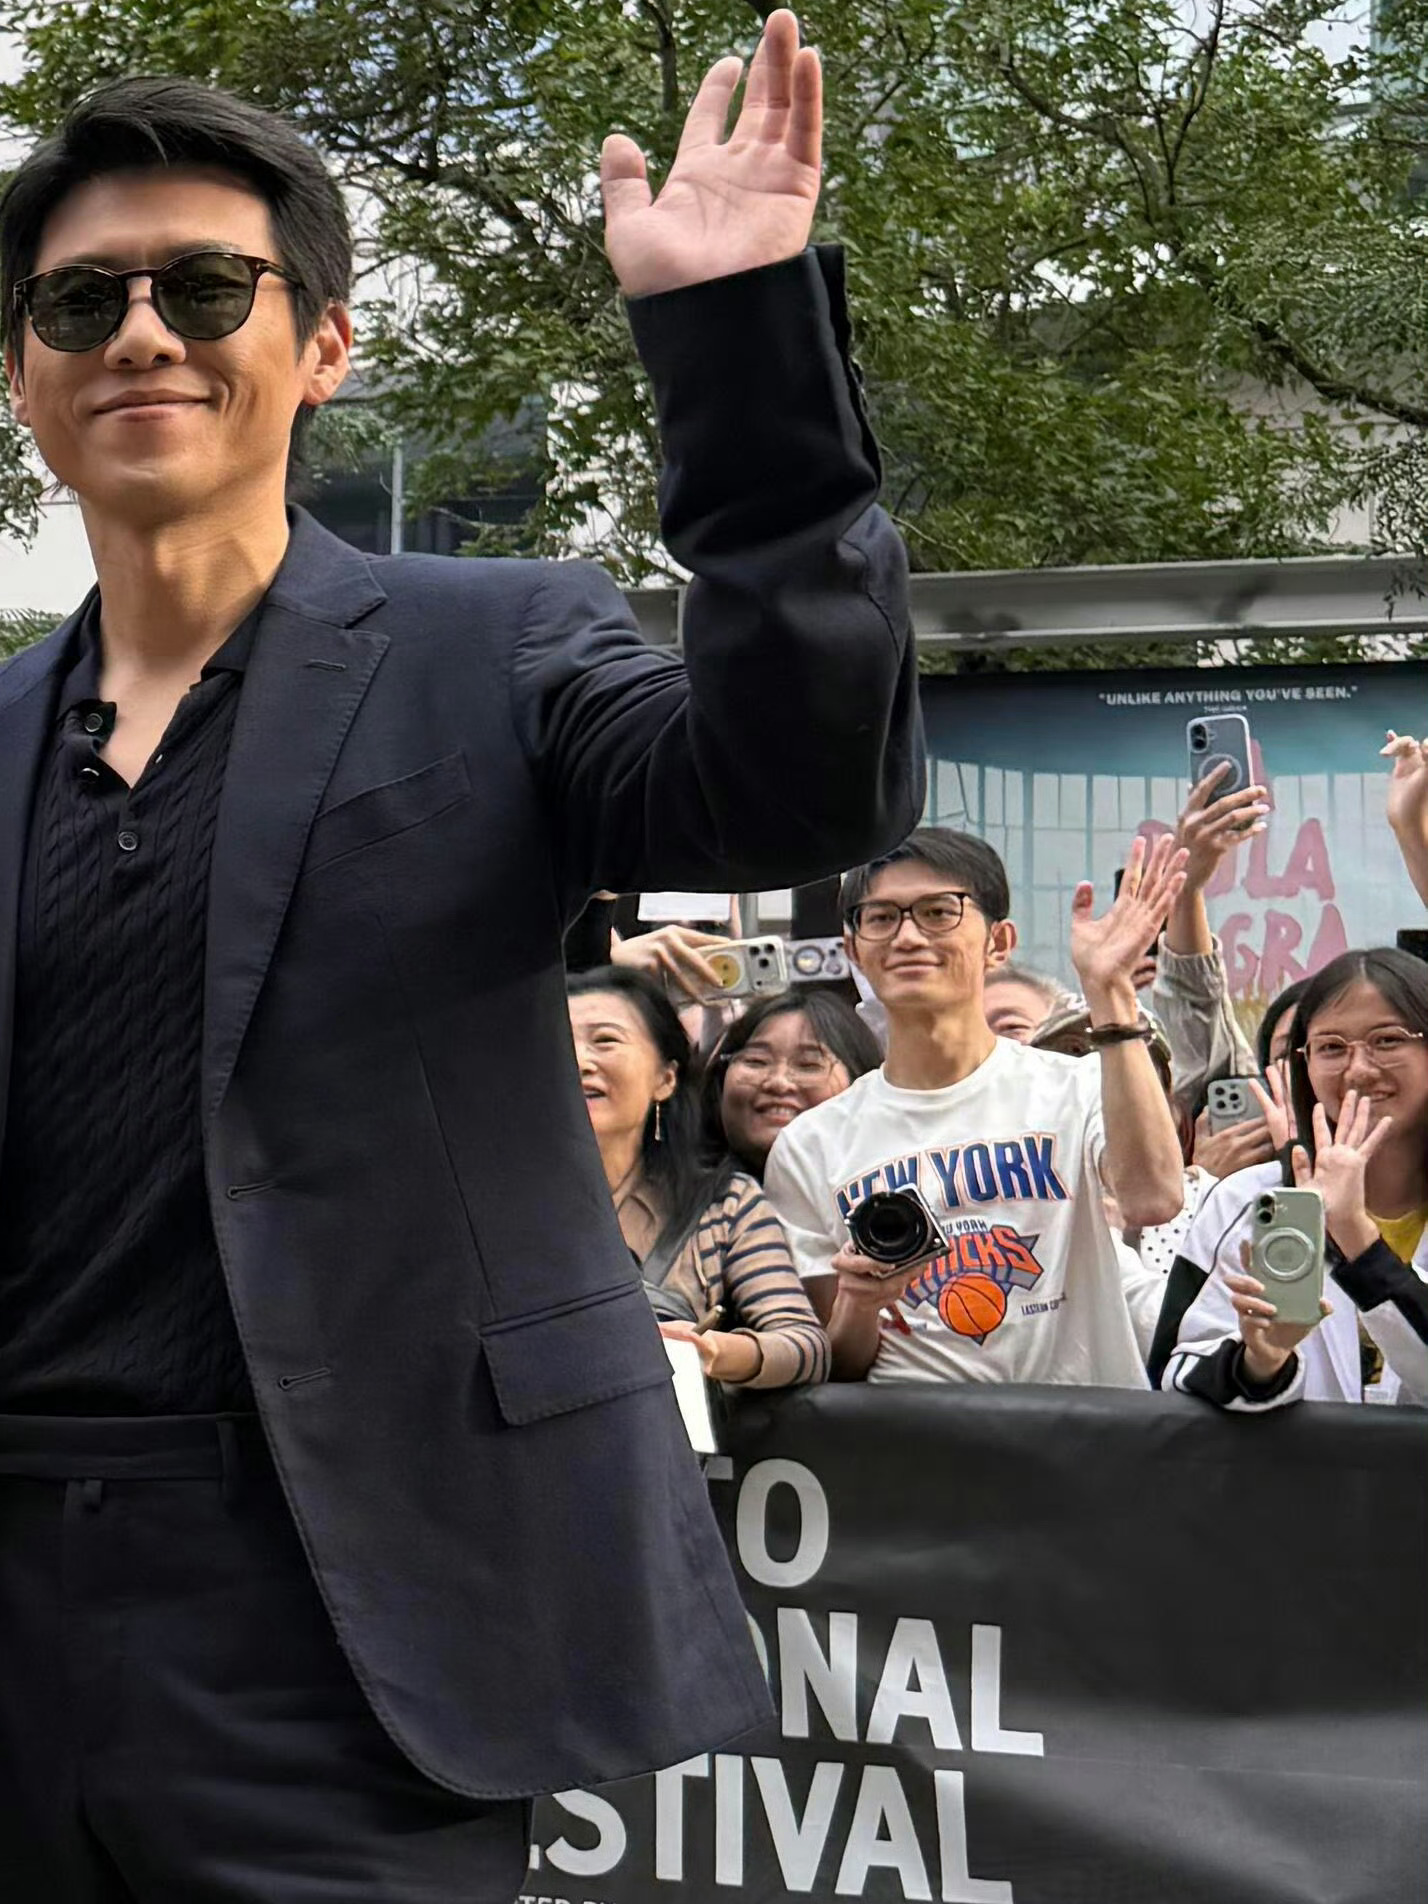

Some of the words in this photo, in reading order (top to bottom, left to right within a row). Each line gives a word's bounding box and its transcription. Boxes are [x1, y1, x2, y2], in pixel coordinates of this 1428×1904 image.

[1164, 689, 1242, 704] ANYTHING
[1245, 687, 1302, 702] YOU'VE
[929, 1134, 1069, 1207] YORK
